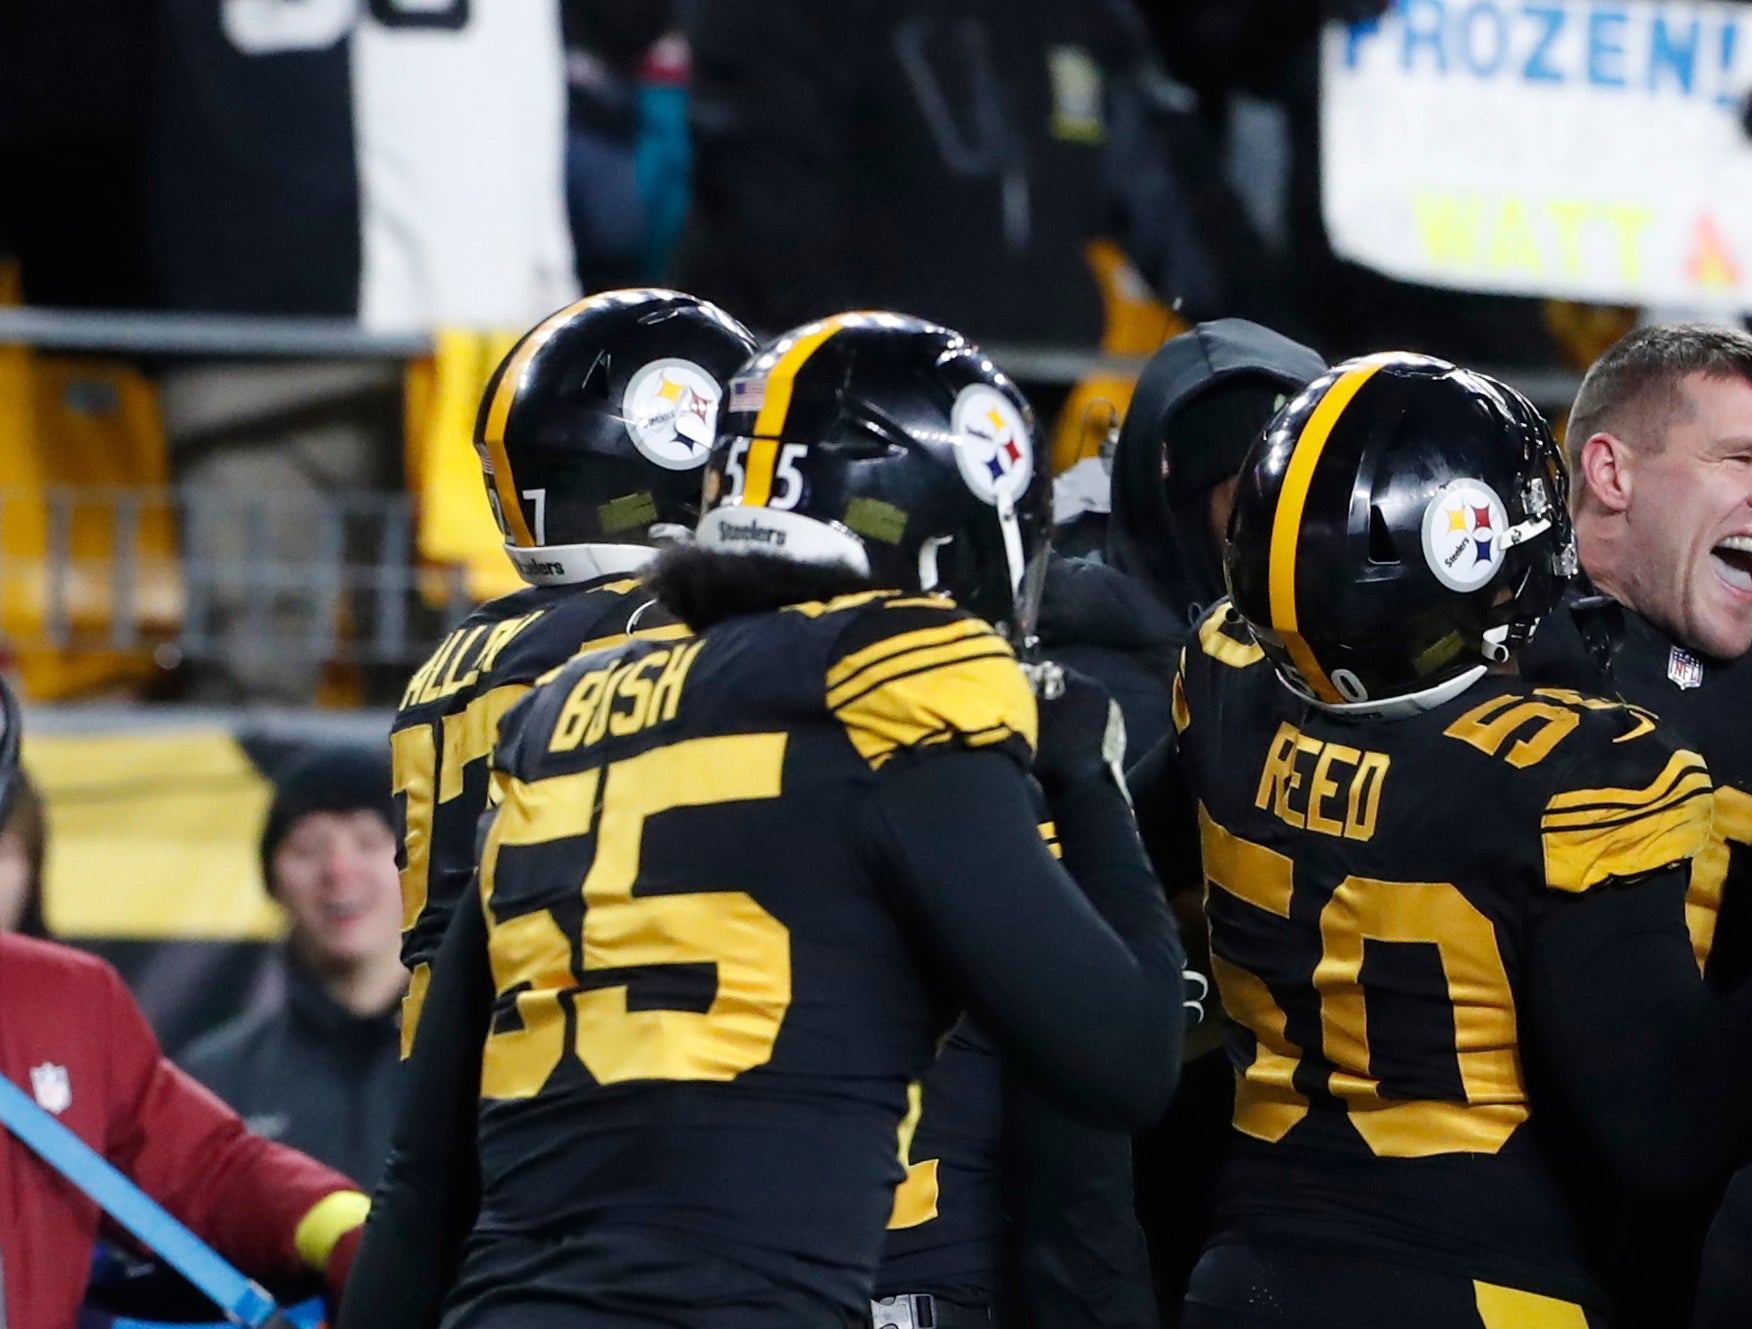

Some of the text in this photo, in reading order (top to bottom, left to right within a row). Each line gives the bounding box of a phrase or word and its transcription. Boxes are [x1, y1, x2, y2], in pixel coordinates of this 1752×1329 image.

[1414, 187, 1653, 283] WATT
[718, 519, 787, 548] Steelers
[1443, 535, 1471, 569] Steelers
[549, 640, 707, 753] BUSH
[1255, 720, 1392, 843] REED
[480, 731, 792, 1100] 55
[1199, 799, 1533, 1158] 50
